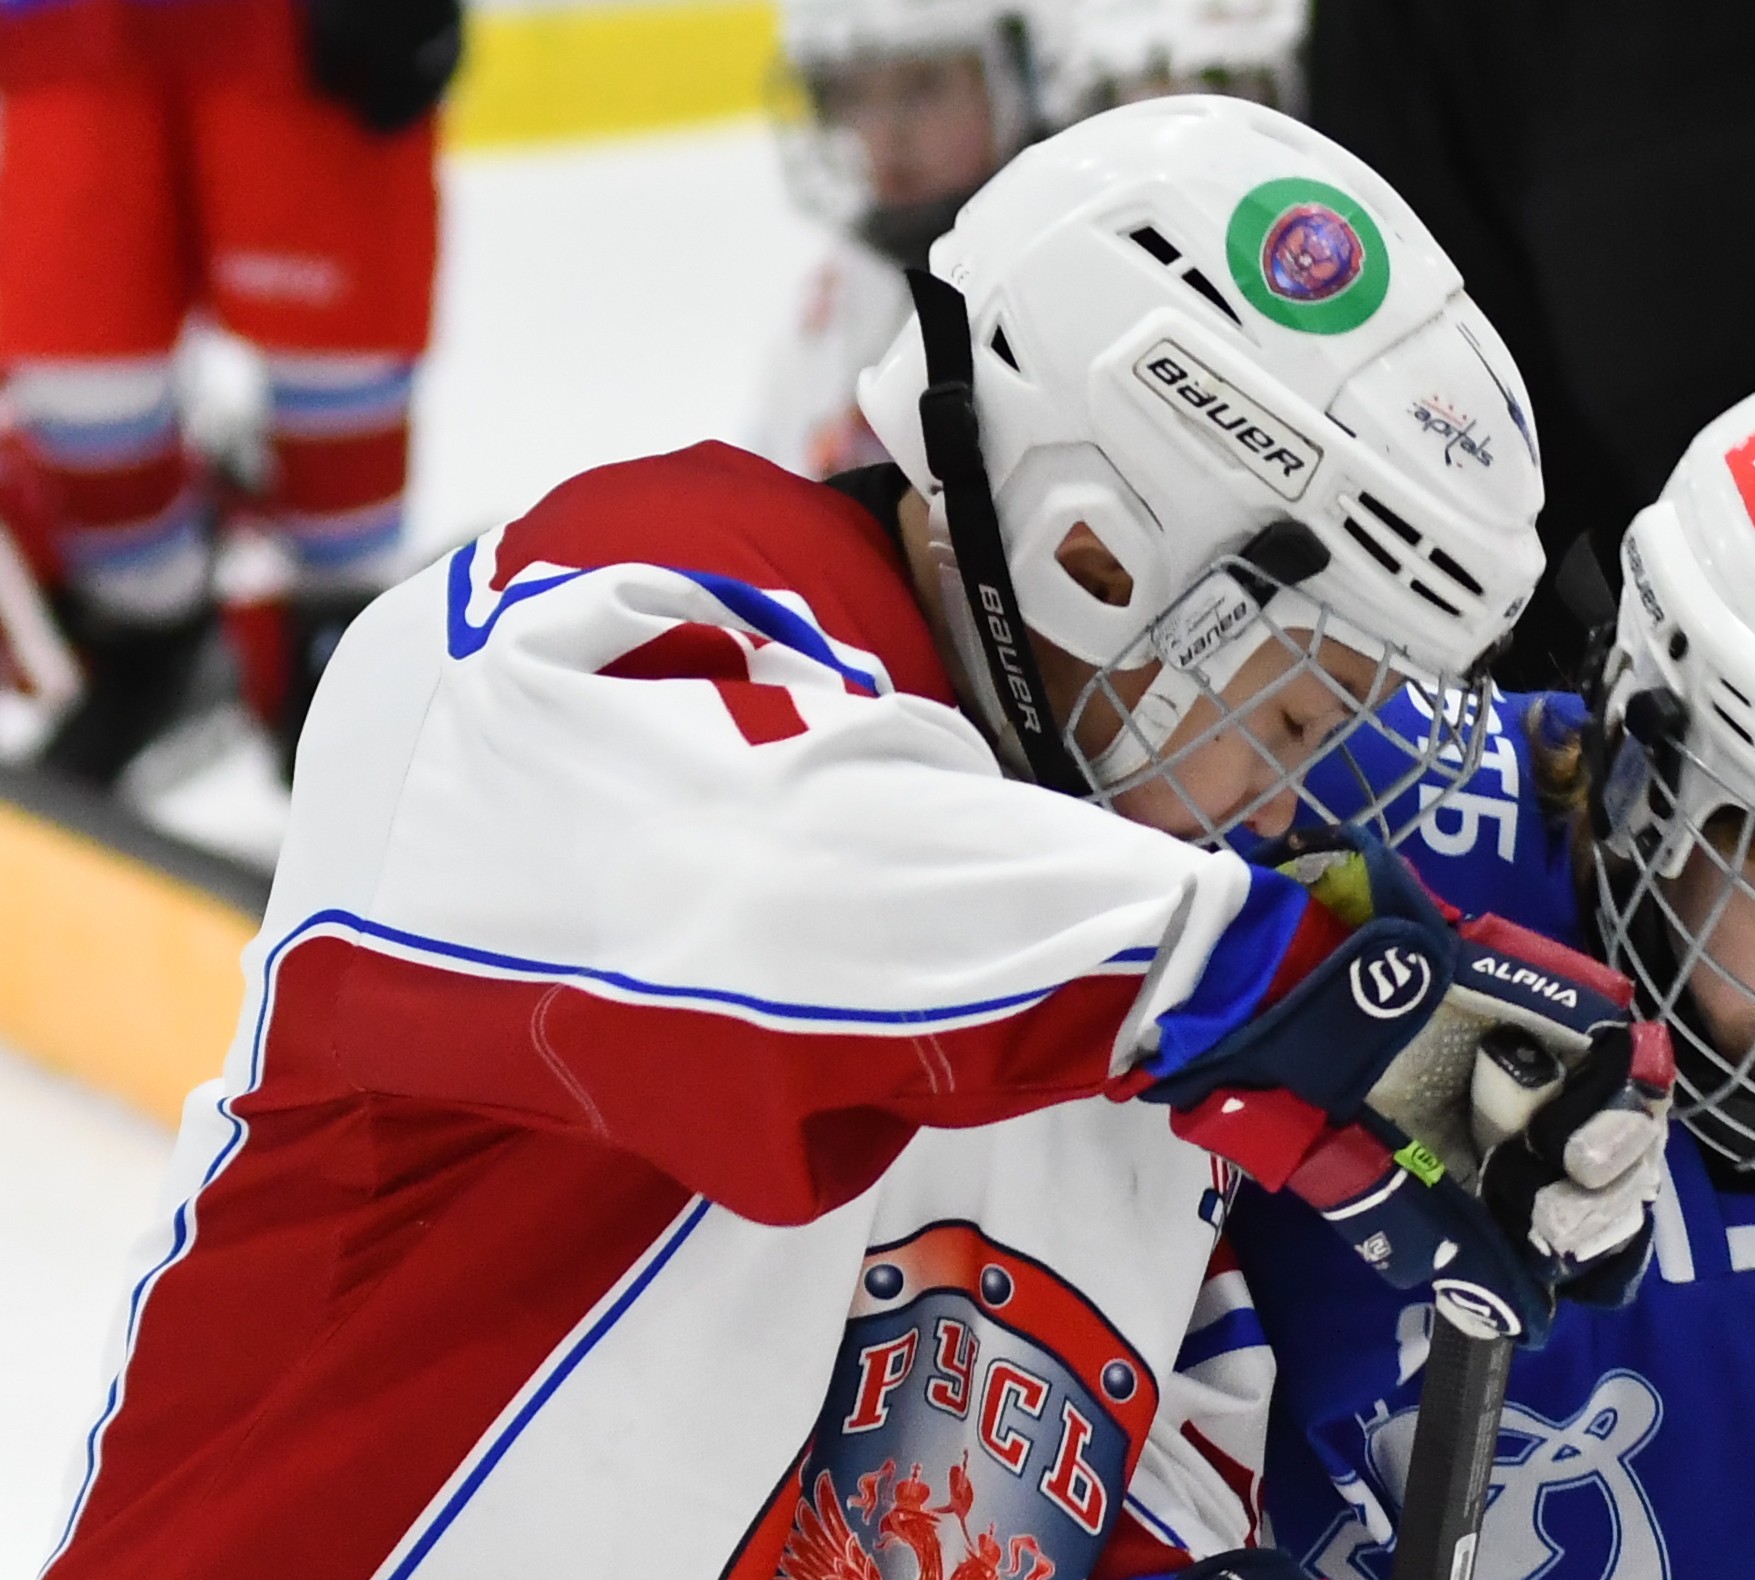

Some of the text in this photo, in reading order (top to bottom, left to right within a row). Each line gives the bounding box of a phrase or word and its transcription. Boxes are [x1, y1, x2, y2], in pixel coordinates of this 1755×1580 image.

[1146, 355, 1305, 478] BAUER
[1407, 401, 1494, 467] apitals
[979, 583, 1040, 735] BAUER
[1472, 956, 1579, 1009] ALPHA
[841, 1316, 1109, 1538] РУСЬ
